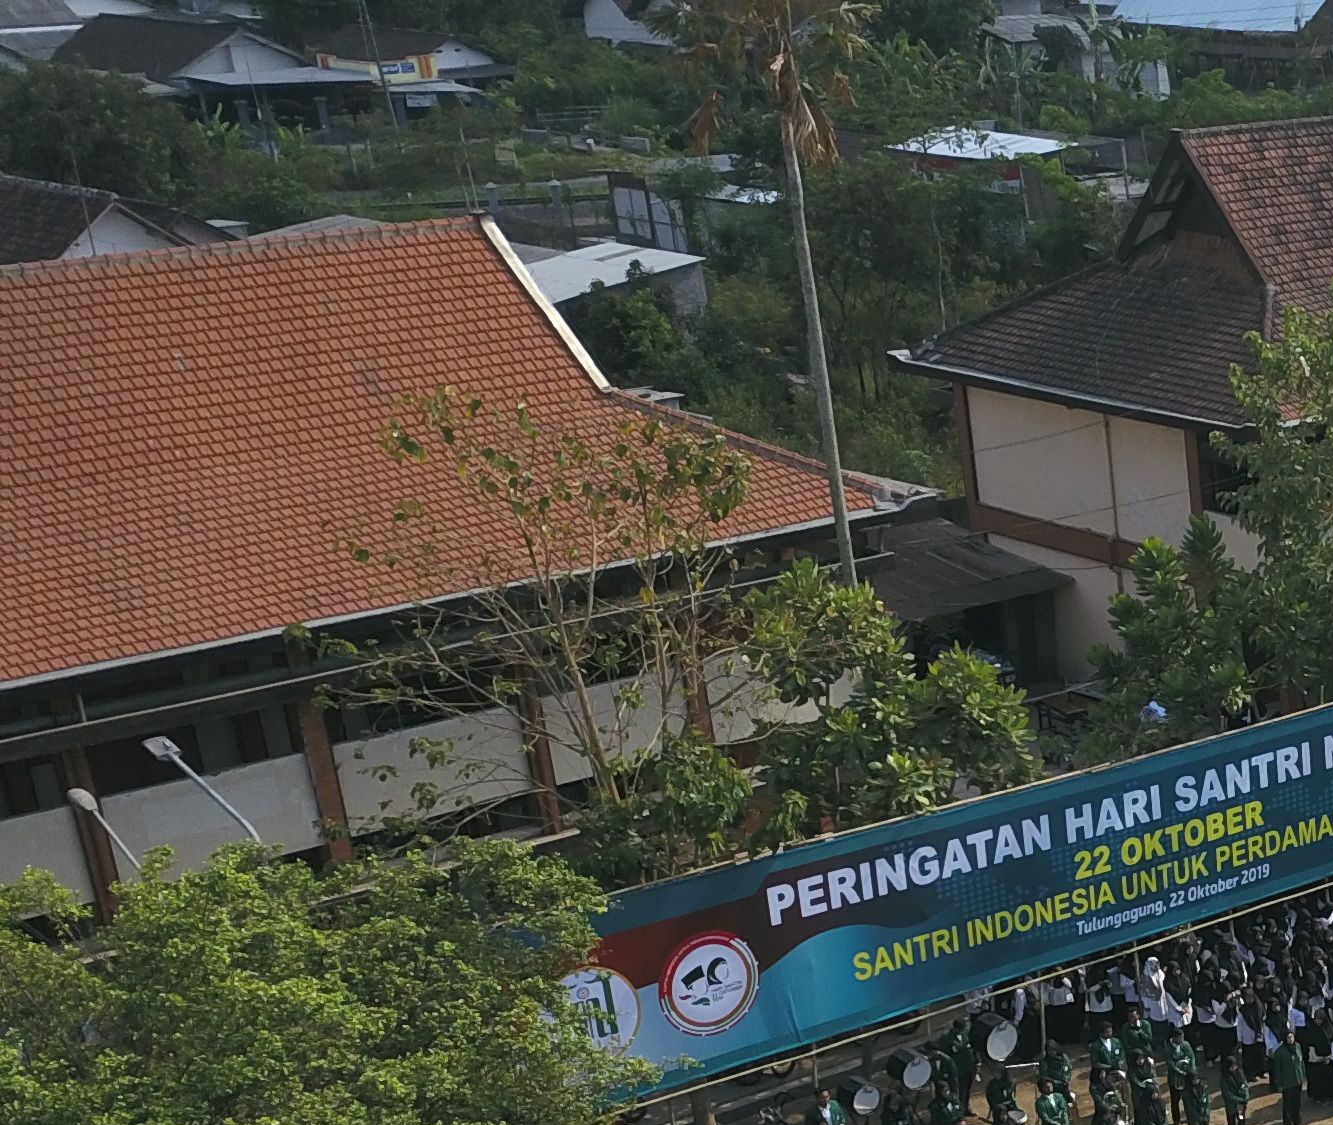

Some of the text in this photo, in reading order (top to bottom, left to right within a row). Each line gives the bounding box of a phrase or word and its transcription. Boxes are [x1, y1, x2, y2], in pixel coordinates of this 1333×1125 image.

[766, 814, 1051, 927] PERINGATAN
[1065, 784, 1162, 844] HARI
[1174, 742, 1311, 812] SANTRI
[1074, 800, 1265, 880] 22 OKTOBER
[853, 925, 959, 980] SANTRI
[966, 881, 1116, 947] INDONESIA
[1121, 851, 1209, 901] UNTUK
[1076, 863, 1270, 936] Tulungagung, 22 Oktober 2019
